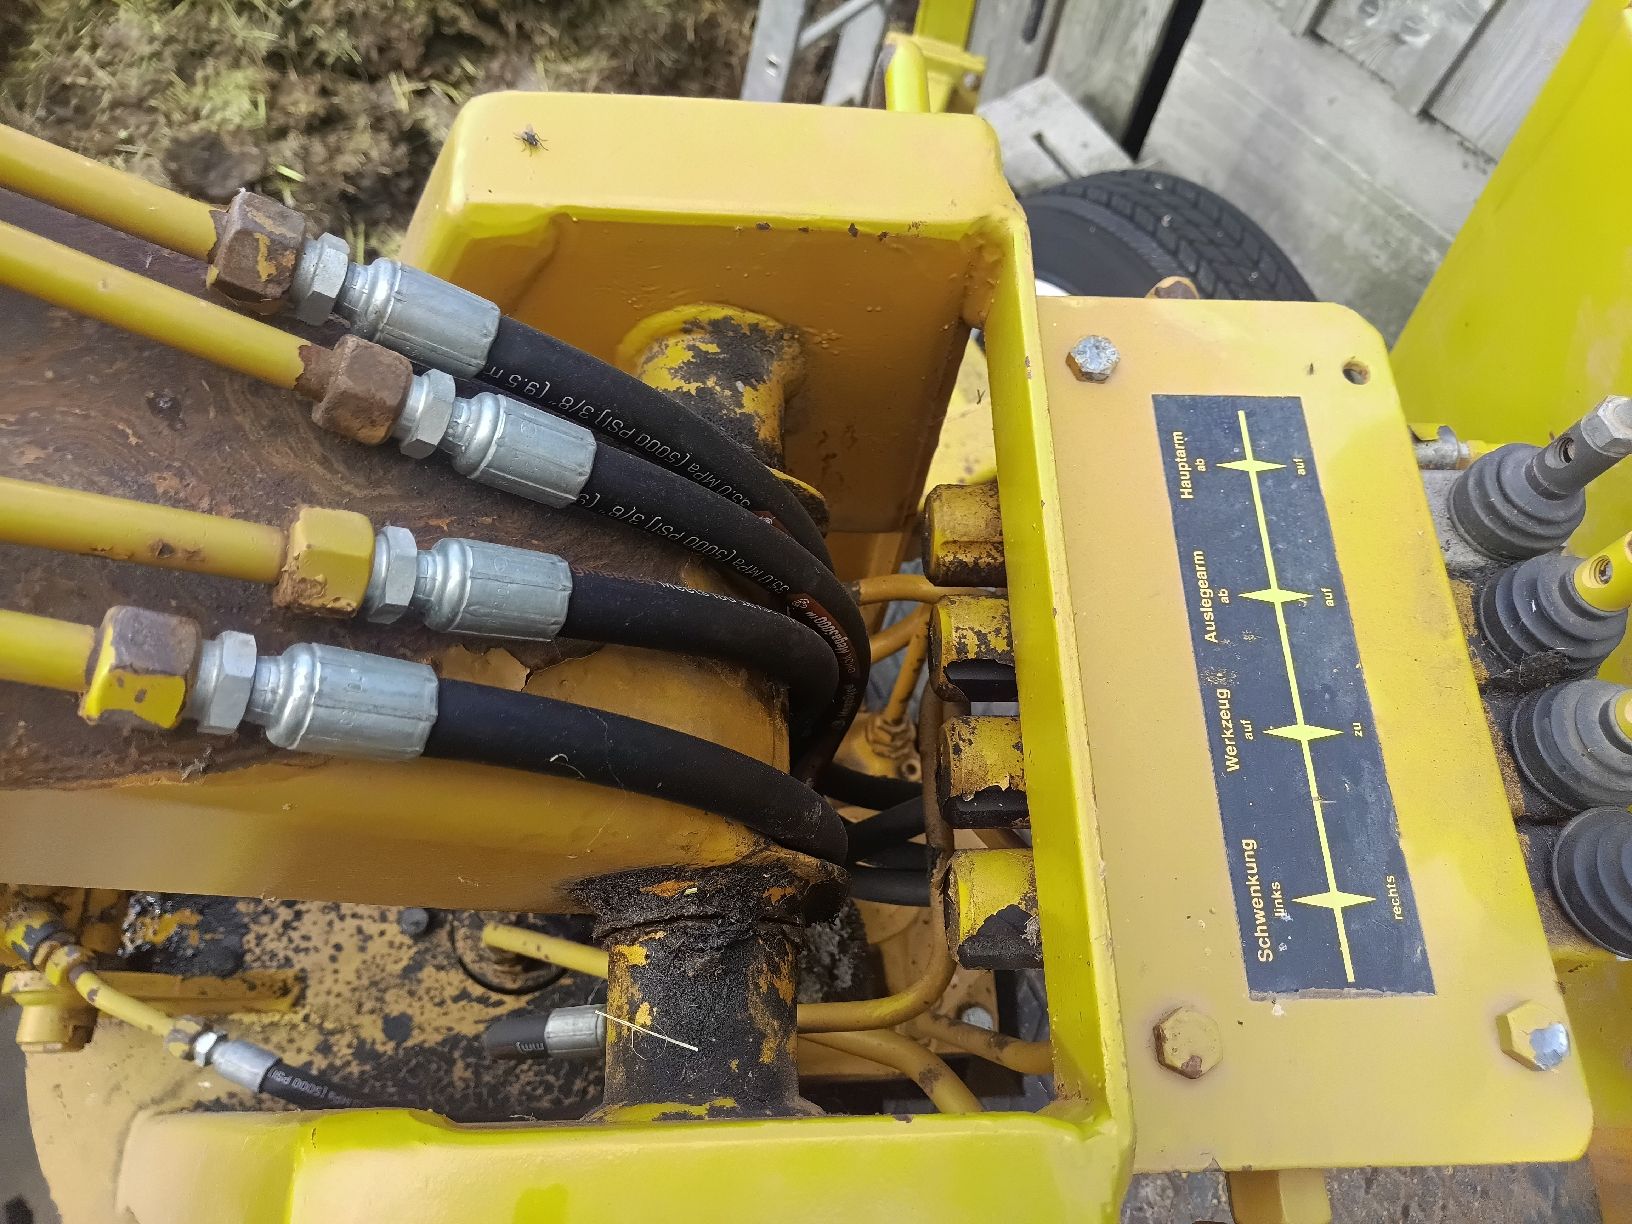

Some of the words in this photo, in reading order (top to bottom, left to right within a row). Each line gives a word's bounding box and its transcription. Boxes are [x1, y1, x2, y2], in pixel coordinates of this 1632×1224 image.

[1172, 431, 1194, 500] Hauptarm
[1195, 457, 1206, 472] ab
[1293, 454, 1307, 476] auf
[1192, 550, 1219, 644] Auslegearm
[1218, 588, 1230, 603] ab
[1321, 587, 1335, 607] auf
[1214, 688, 1241, 773] Werkzeug
[1240, 719, 1254, 741] auf
[1352, 722, 1364, 738] zu
[1240, 839, 1275, 963] Schwenkung
[1271, 881, 1288, 918] links
[1385, 875, 1404, 920] rechts
